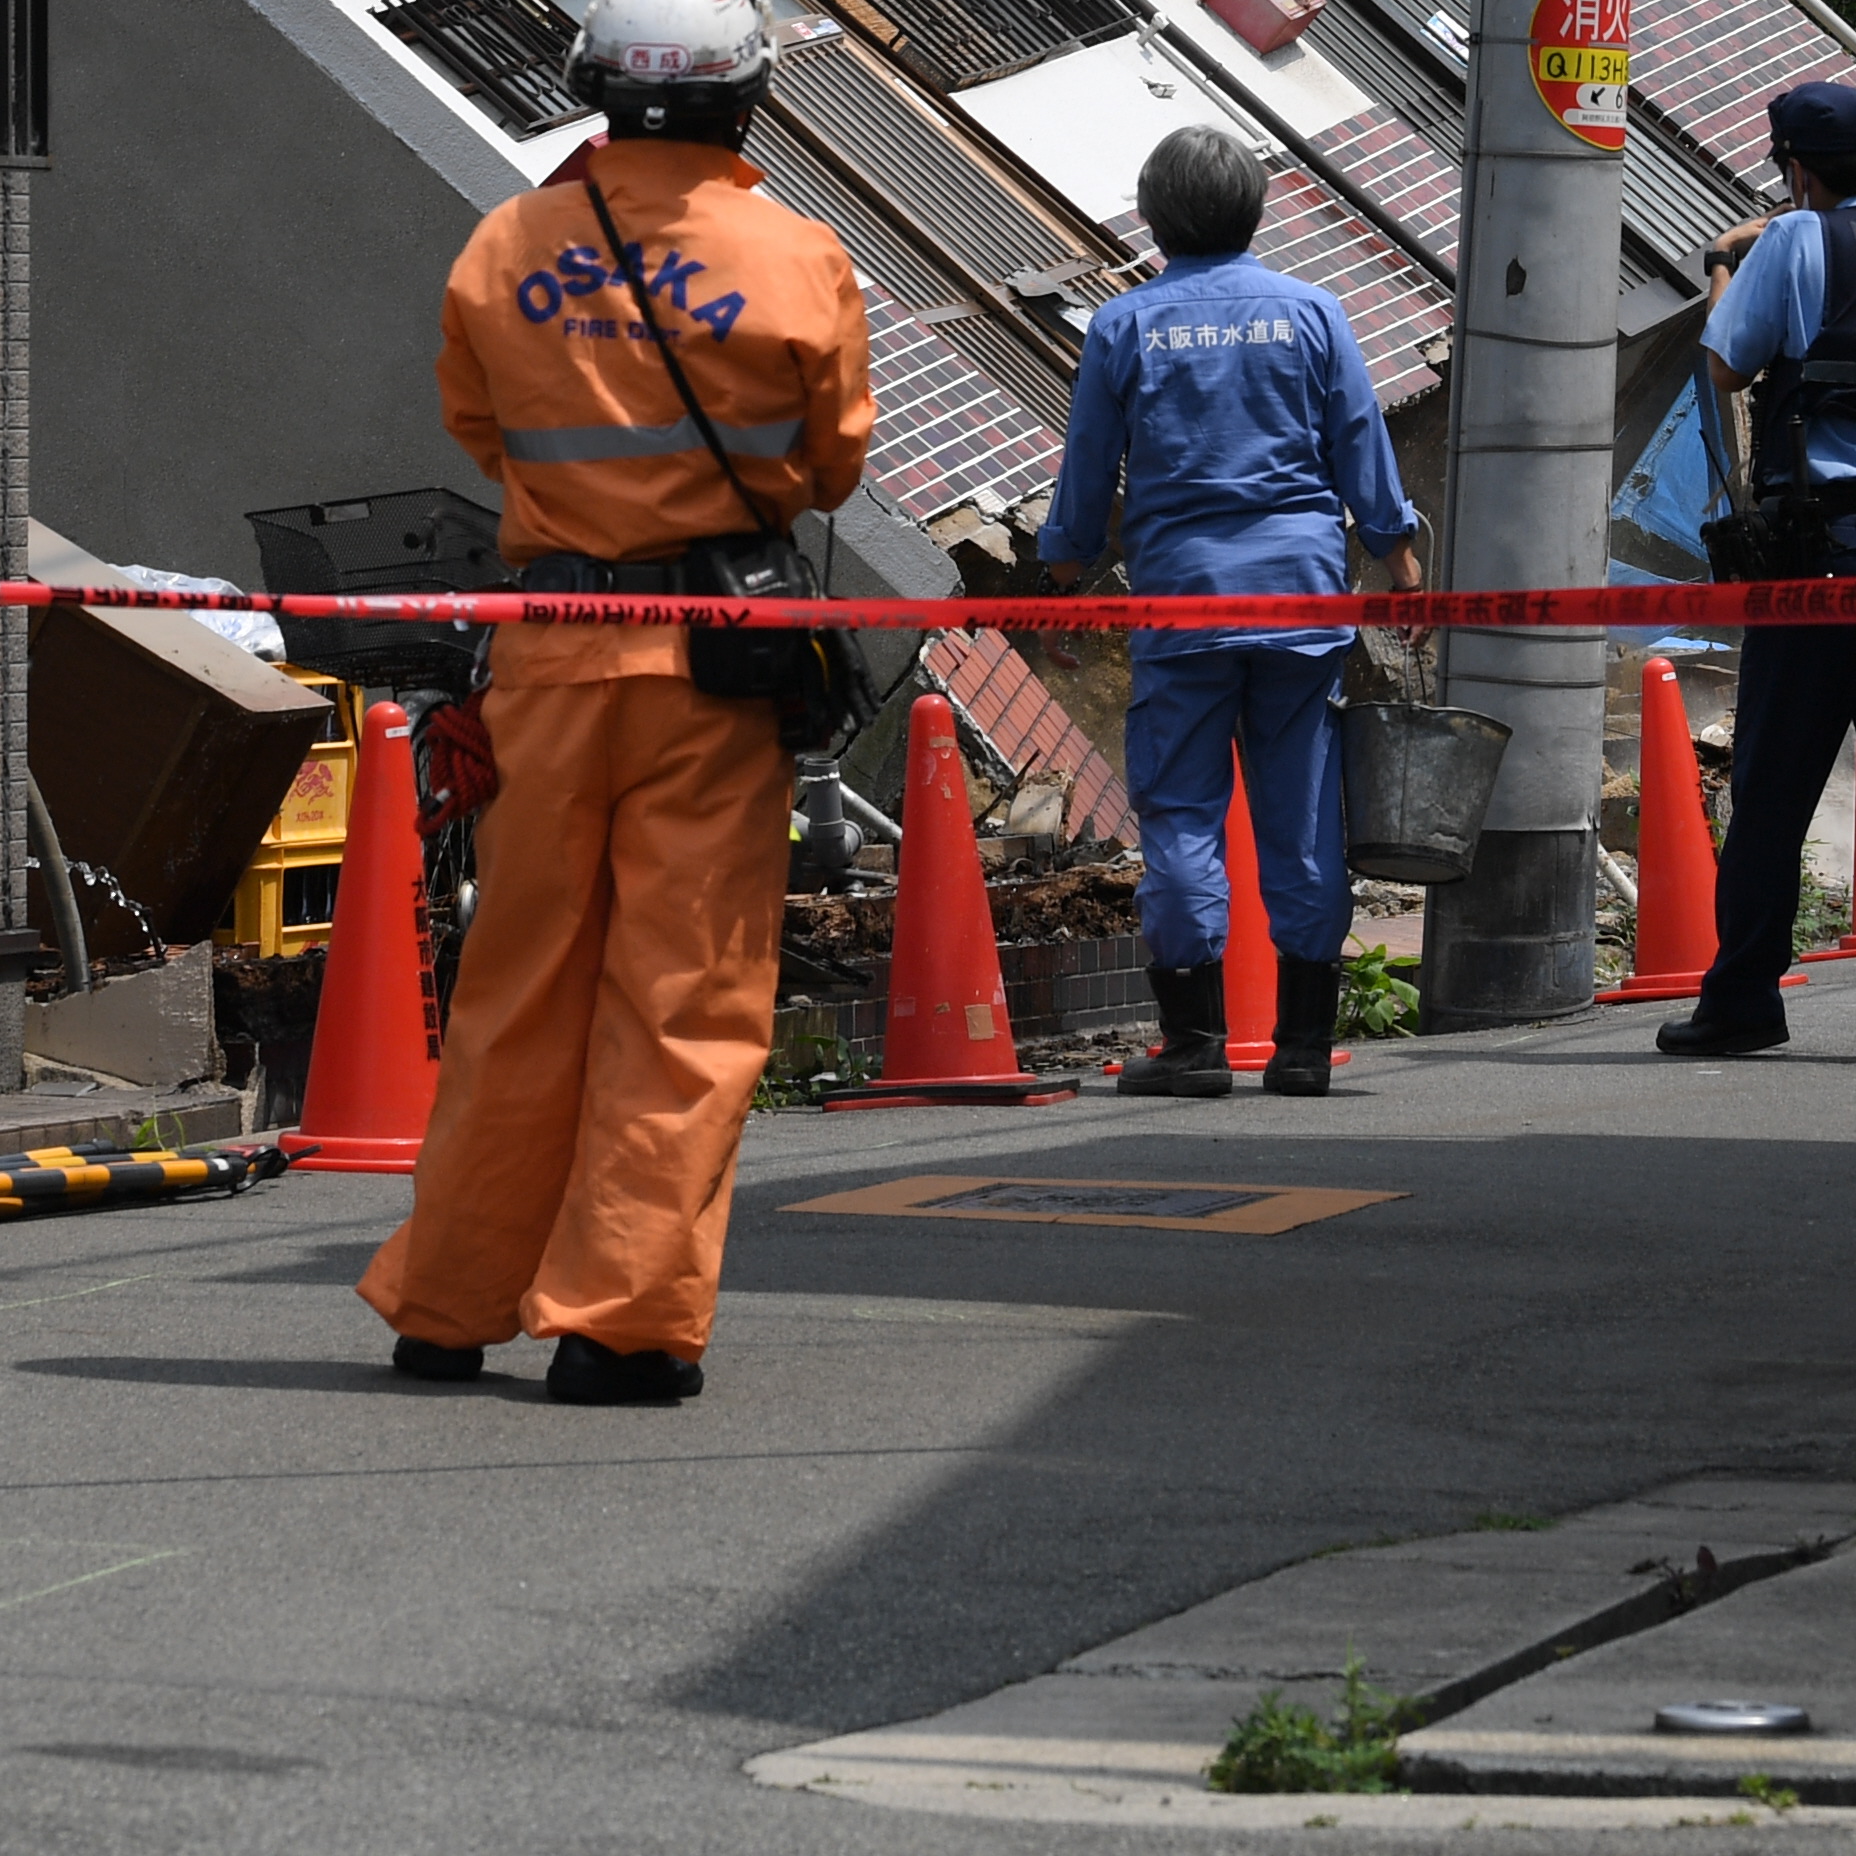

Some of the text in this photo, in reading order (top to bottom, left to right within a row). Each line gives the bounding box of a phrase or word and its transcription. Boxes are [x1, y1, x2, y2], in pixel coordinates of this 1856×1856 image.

[630, 49, 682, 70] 西成
[516, 241, 747, 343] OSAKA
[563, 318, 618, 339] FIRE
[1145, 319, 1294, 352] 大阪市水道局
